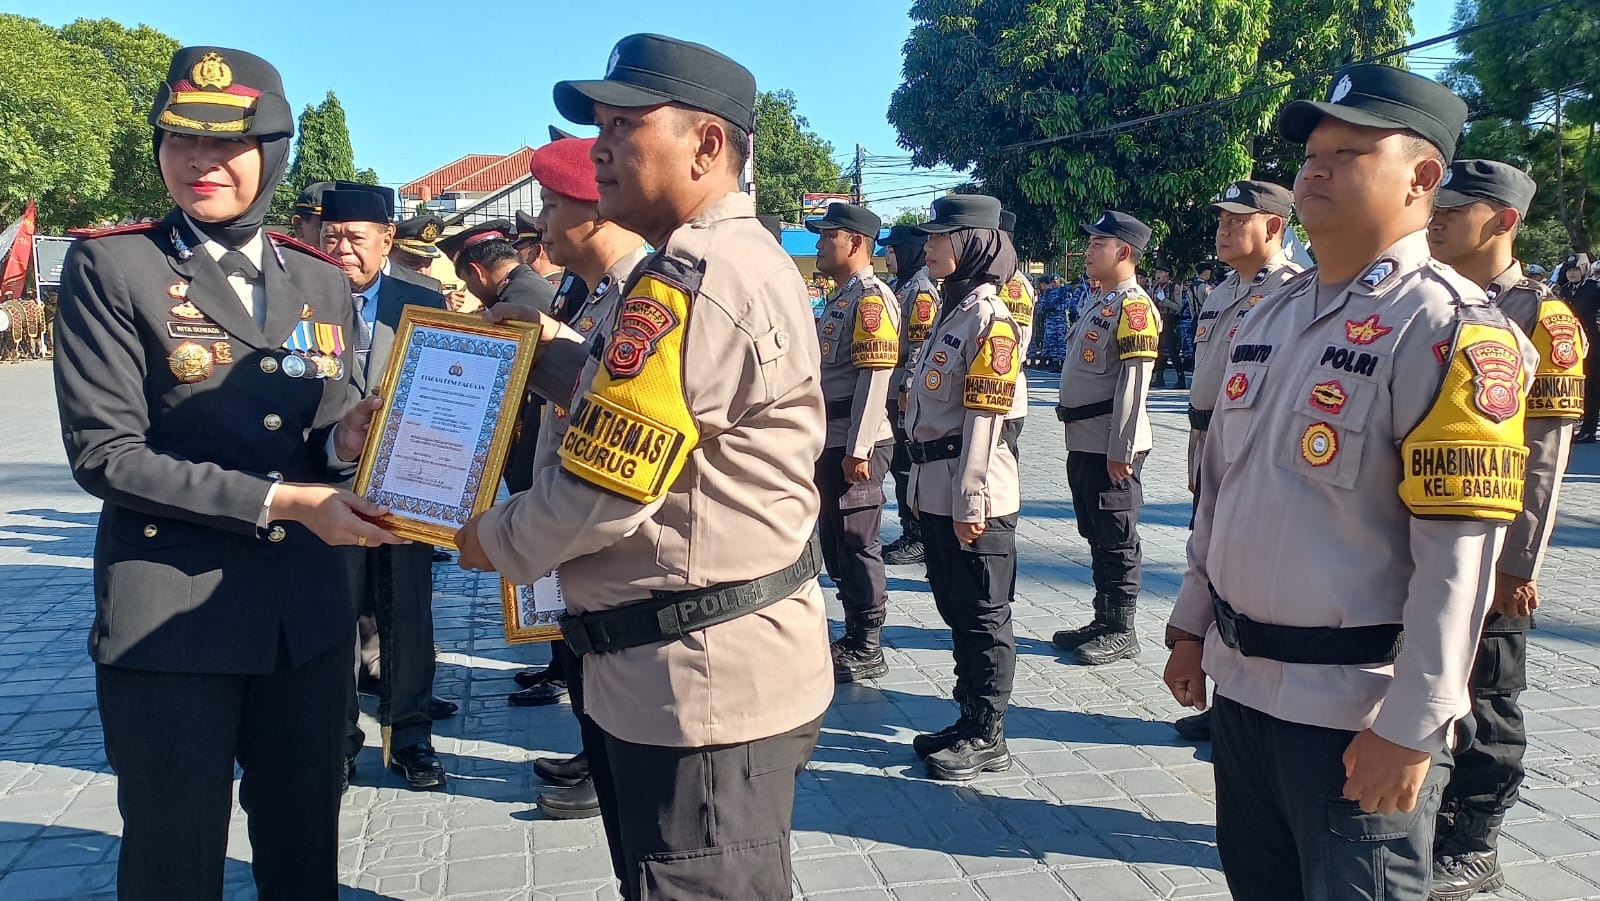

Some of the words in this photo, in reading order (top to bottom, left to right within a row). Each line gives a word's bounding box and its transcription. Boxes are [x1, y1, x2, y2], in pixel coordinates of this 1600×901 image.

[1320, 346, 1379, 377] POLRI
[564, 431, 638, 479] CICURUG
[1424, 478, 1455, 497] KEL.
